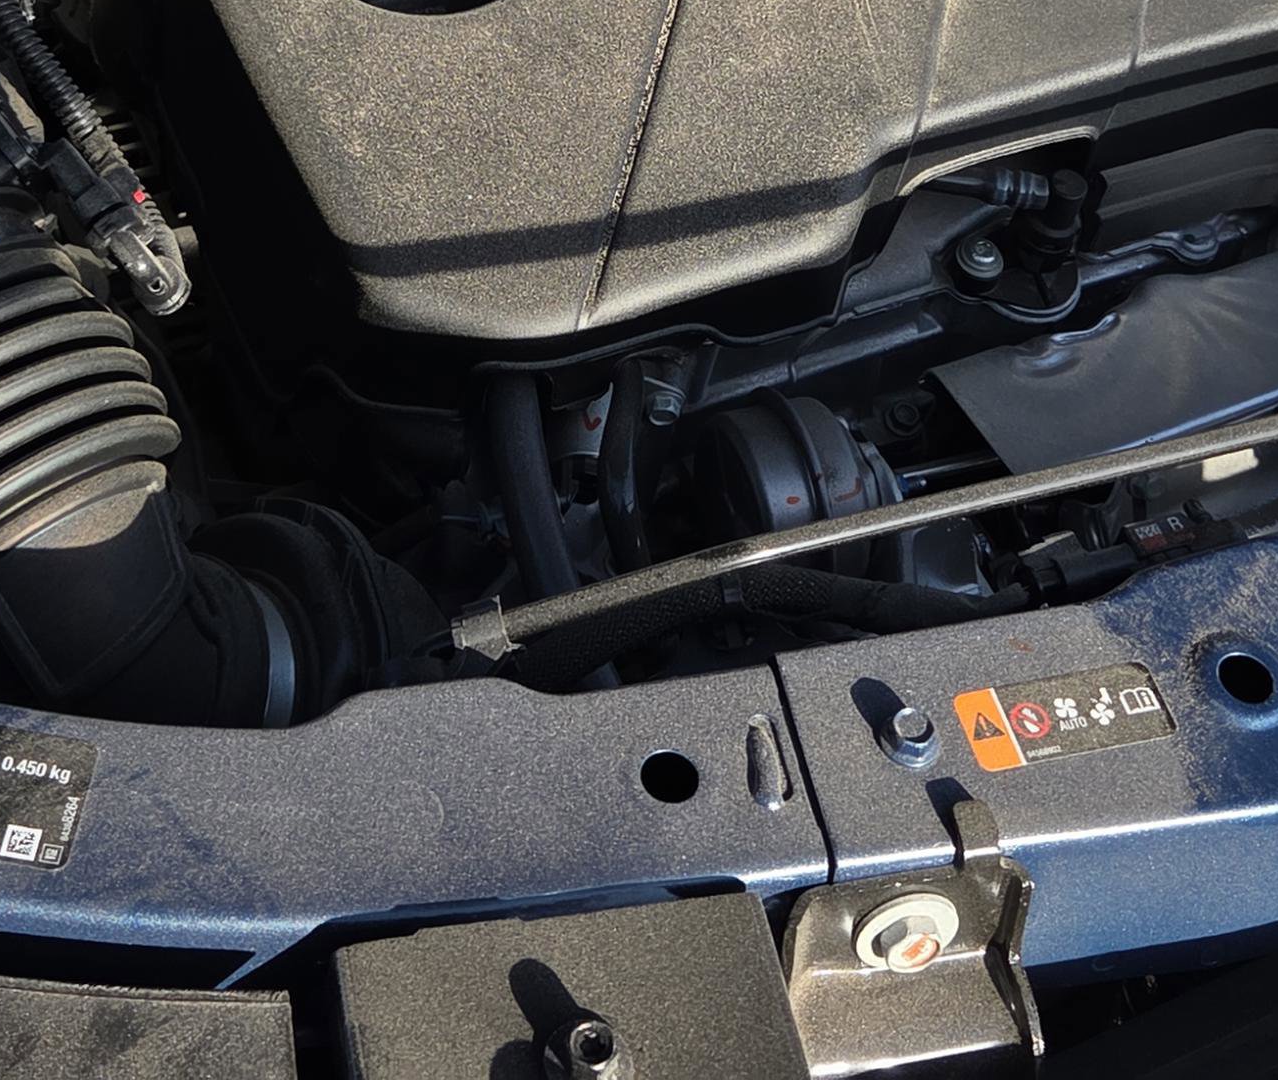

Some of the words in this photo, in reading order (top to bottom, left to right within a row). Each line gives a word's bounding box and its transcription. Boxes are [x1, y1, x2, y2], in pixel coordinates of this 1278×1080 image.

[1059, 716, 1088, 732] AUTO
[1, 754, 48, 778] 0.450
[49, 761, 72, 784] kg
